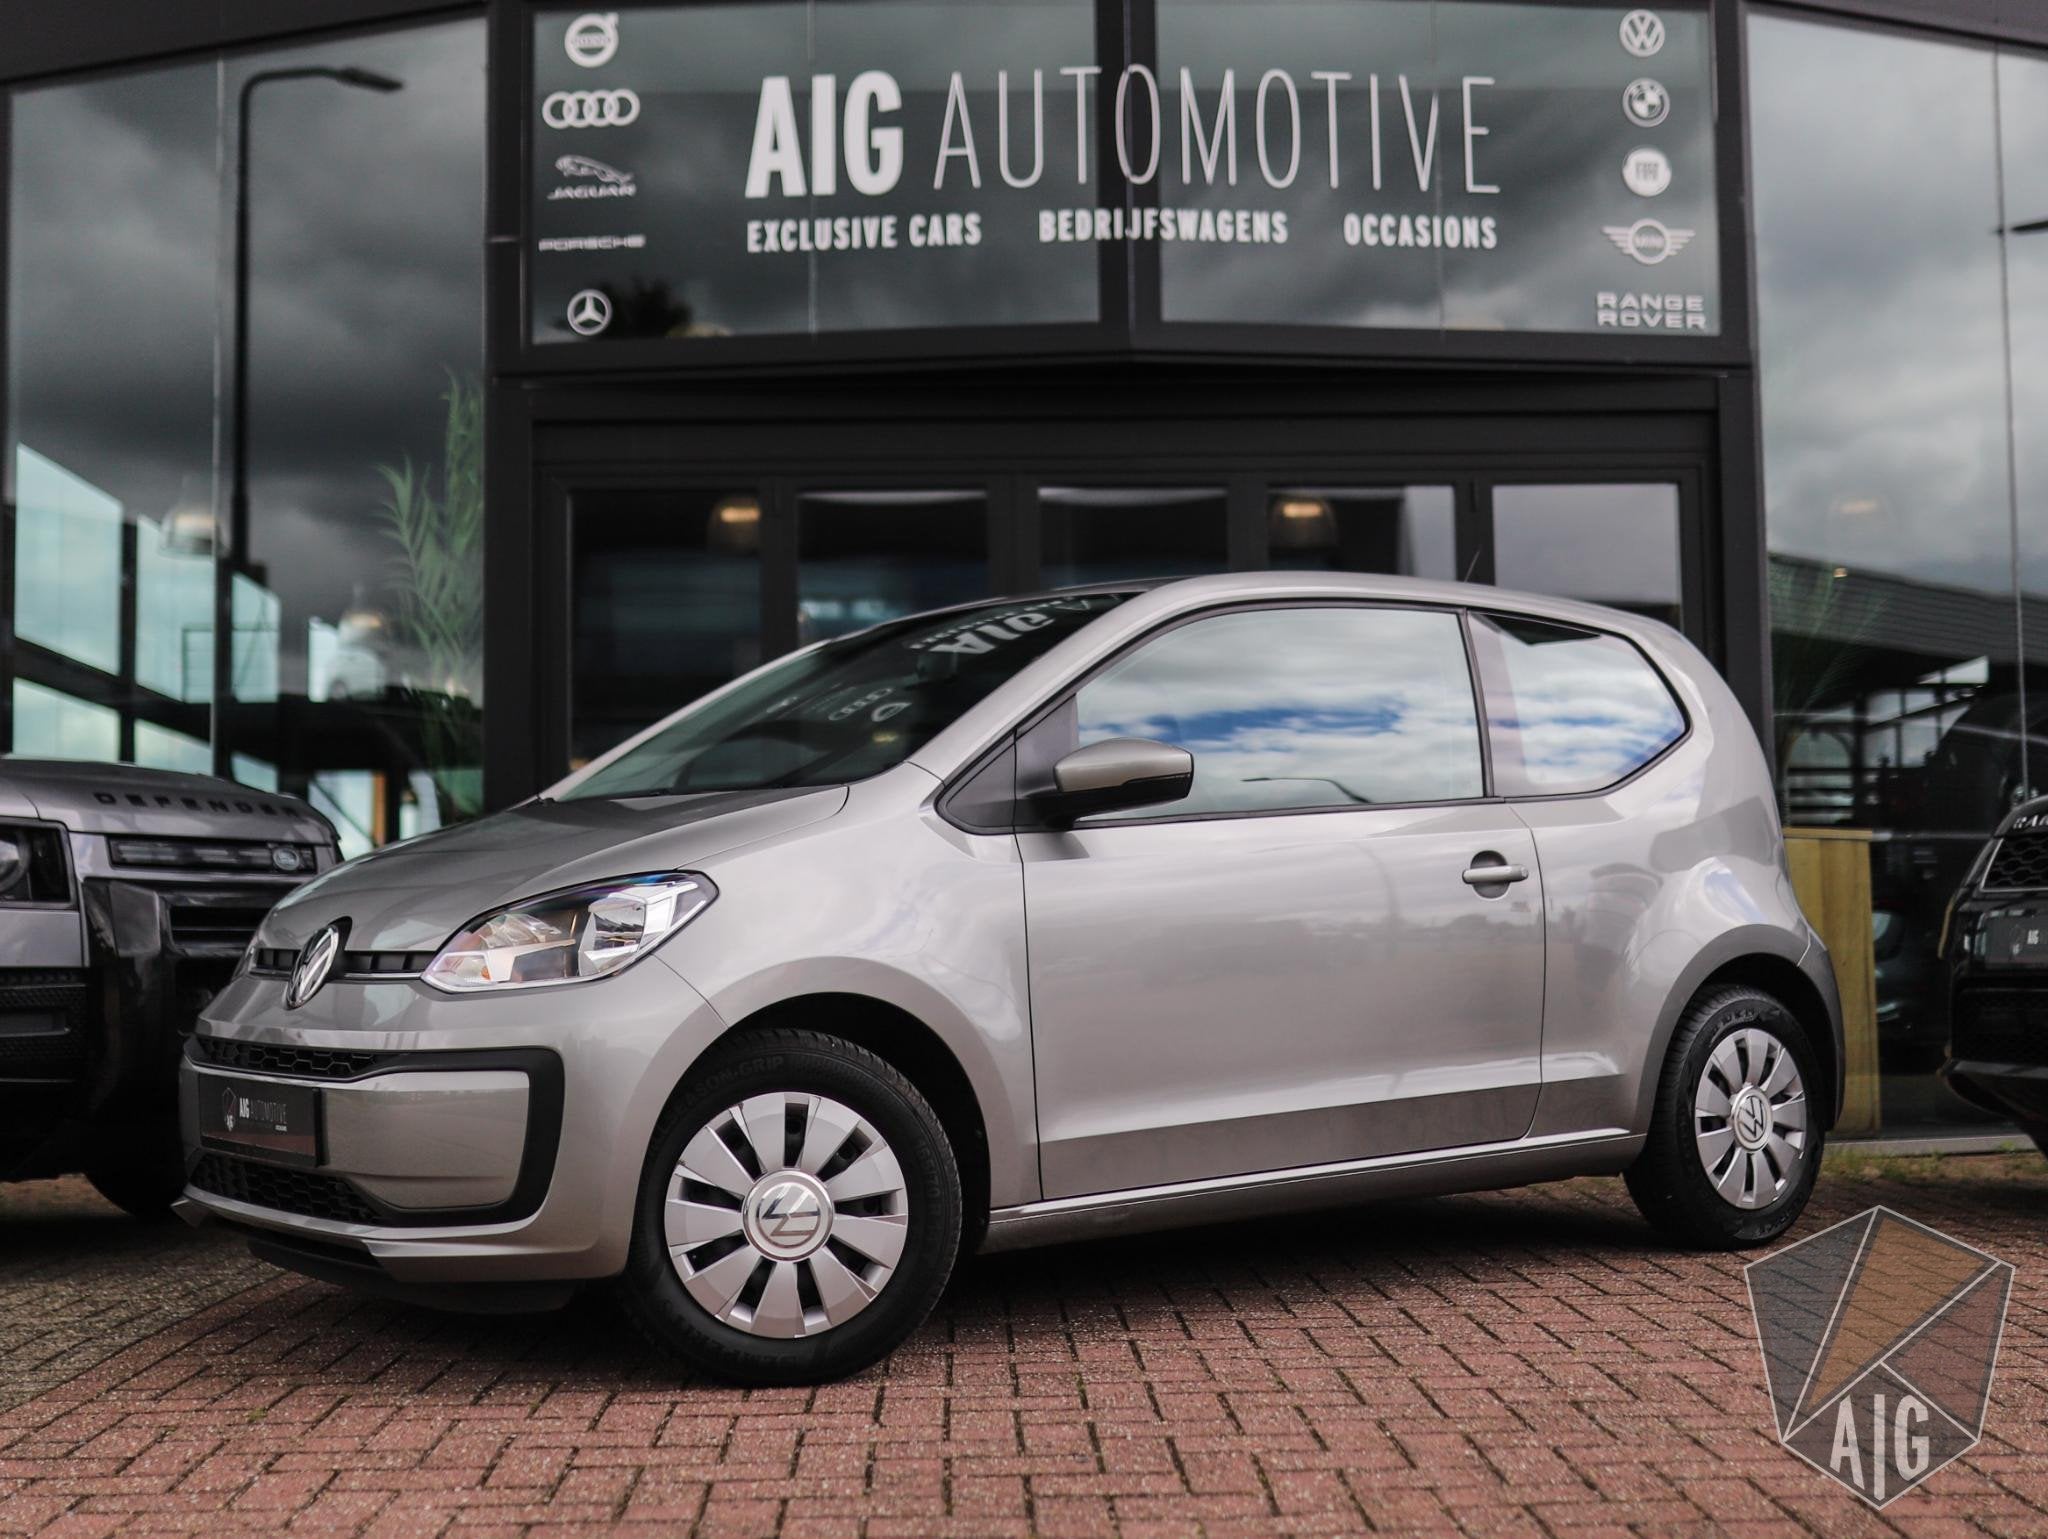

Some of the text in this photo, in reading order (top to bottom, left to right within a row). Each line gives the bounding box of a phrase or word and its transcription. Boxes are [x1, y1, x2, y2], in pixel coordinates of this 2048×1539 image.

[745, 64, 1501, 199] AIG AUTOMOTIVE
[547, 183, 637, 199] JAGUAR
[746, 208, 1498, 254] EXCLUSIVE CARS BEDRIJFSWAGENS OCCASIONS
[538, 235, 646, 251] PORSCHE
[1597, 292, 1704, 312] RANGE
[1597, 309, 1707, 330] ROVER
